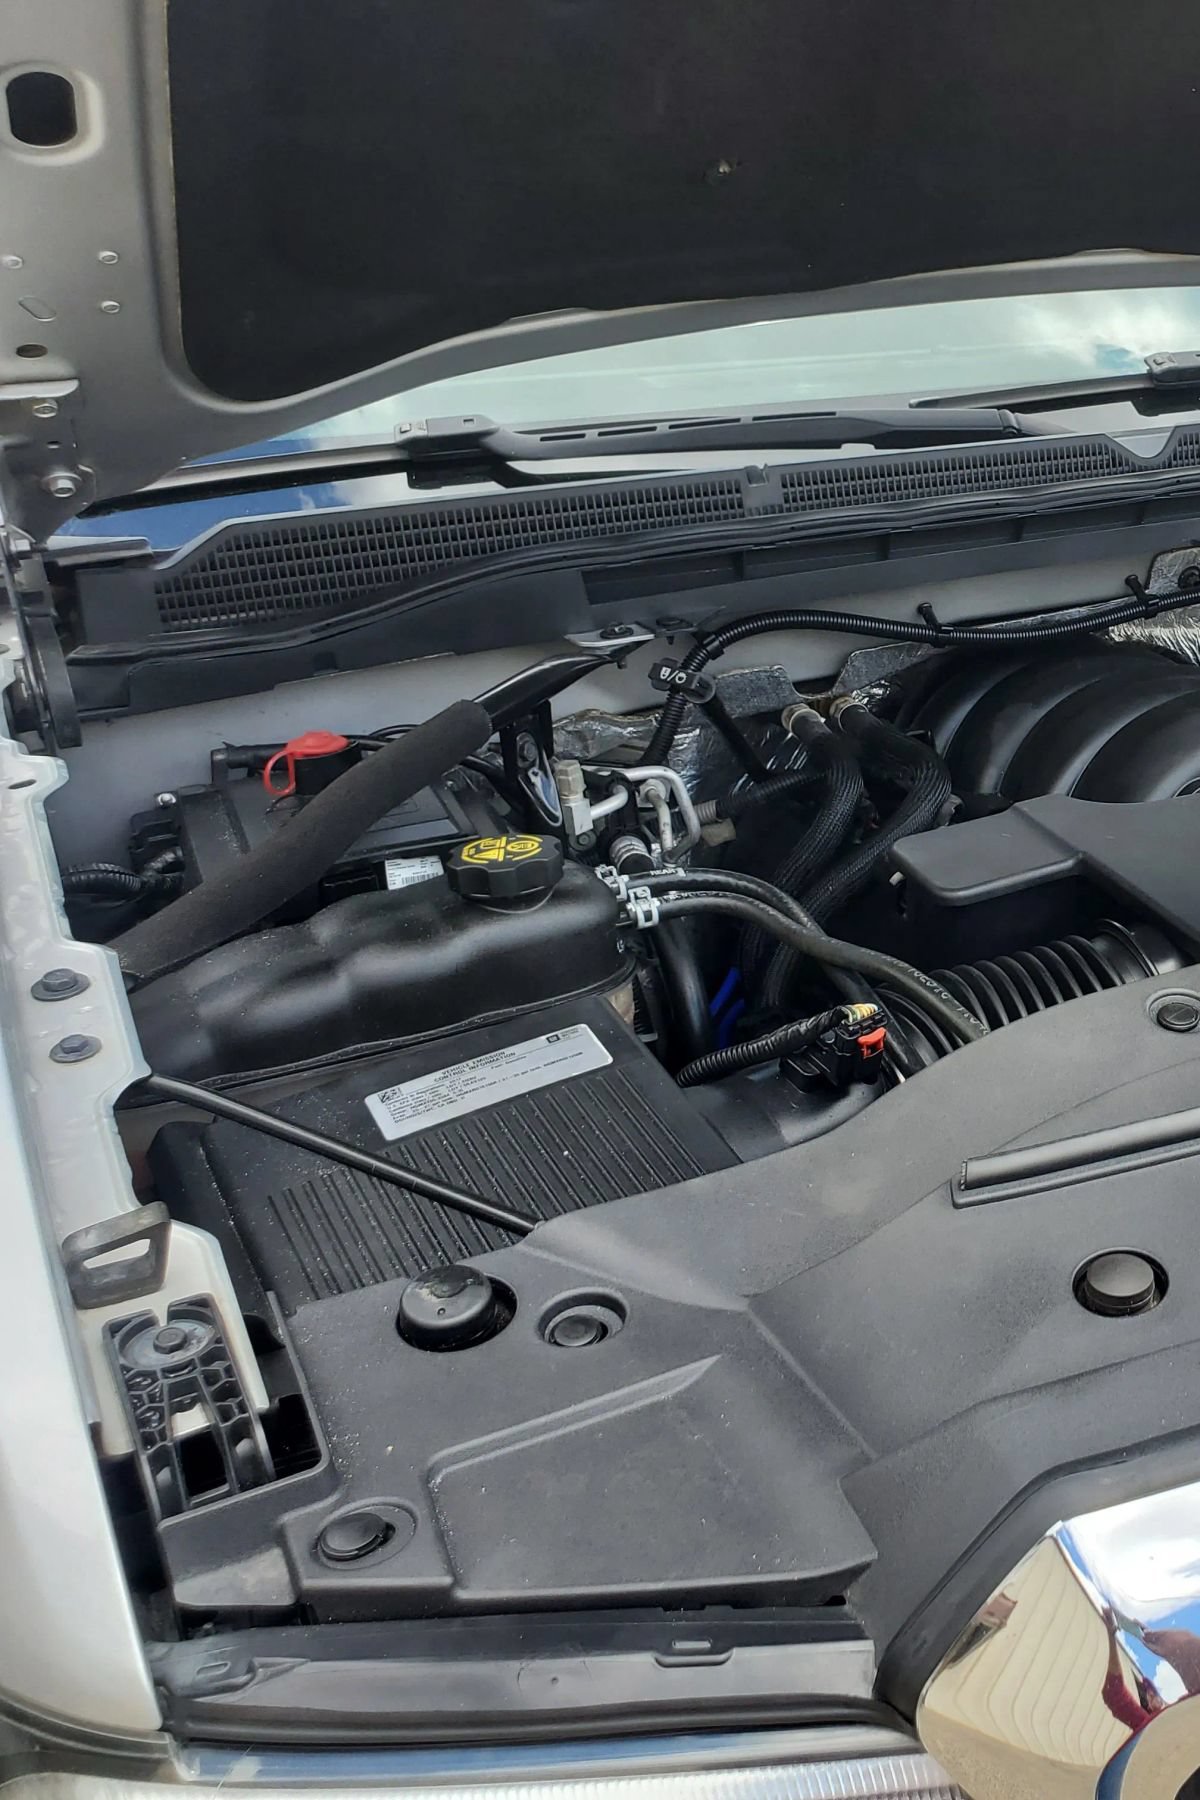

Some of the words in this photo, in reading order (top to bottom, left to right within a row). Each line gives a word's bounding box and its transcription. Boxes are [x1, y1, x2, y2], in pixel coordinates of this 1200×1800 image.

[434, 1068, 467, 1083] CONTROL
[468, 1052, 516, 1072] INFORMATION
[441, 1062, 471, 1076] VEHICLE
[472, 1051, 506, 1066] EMISSION
